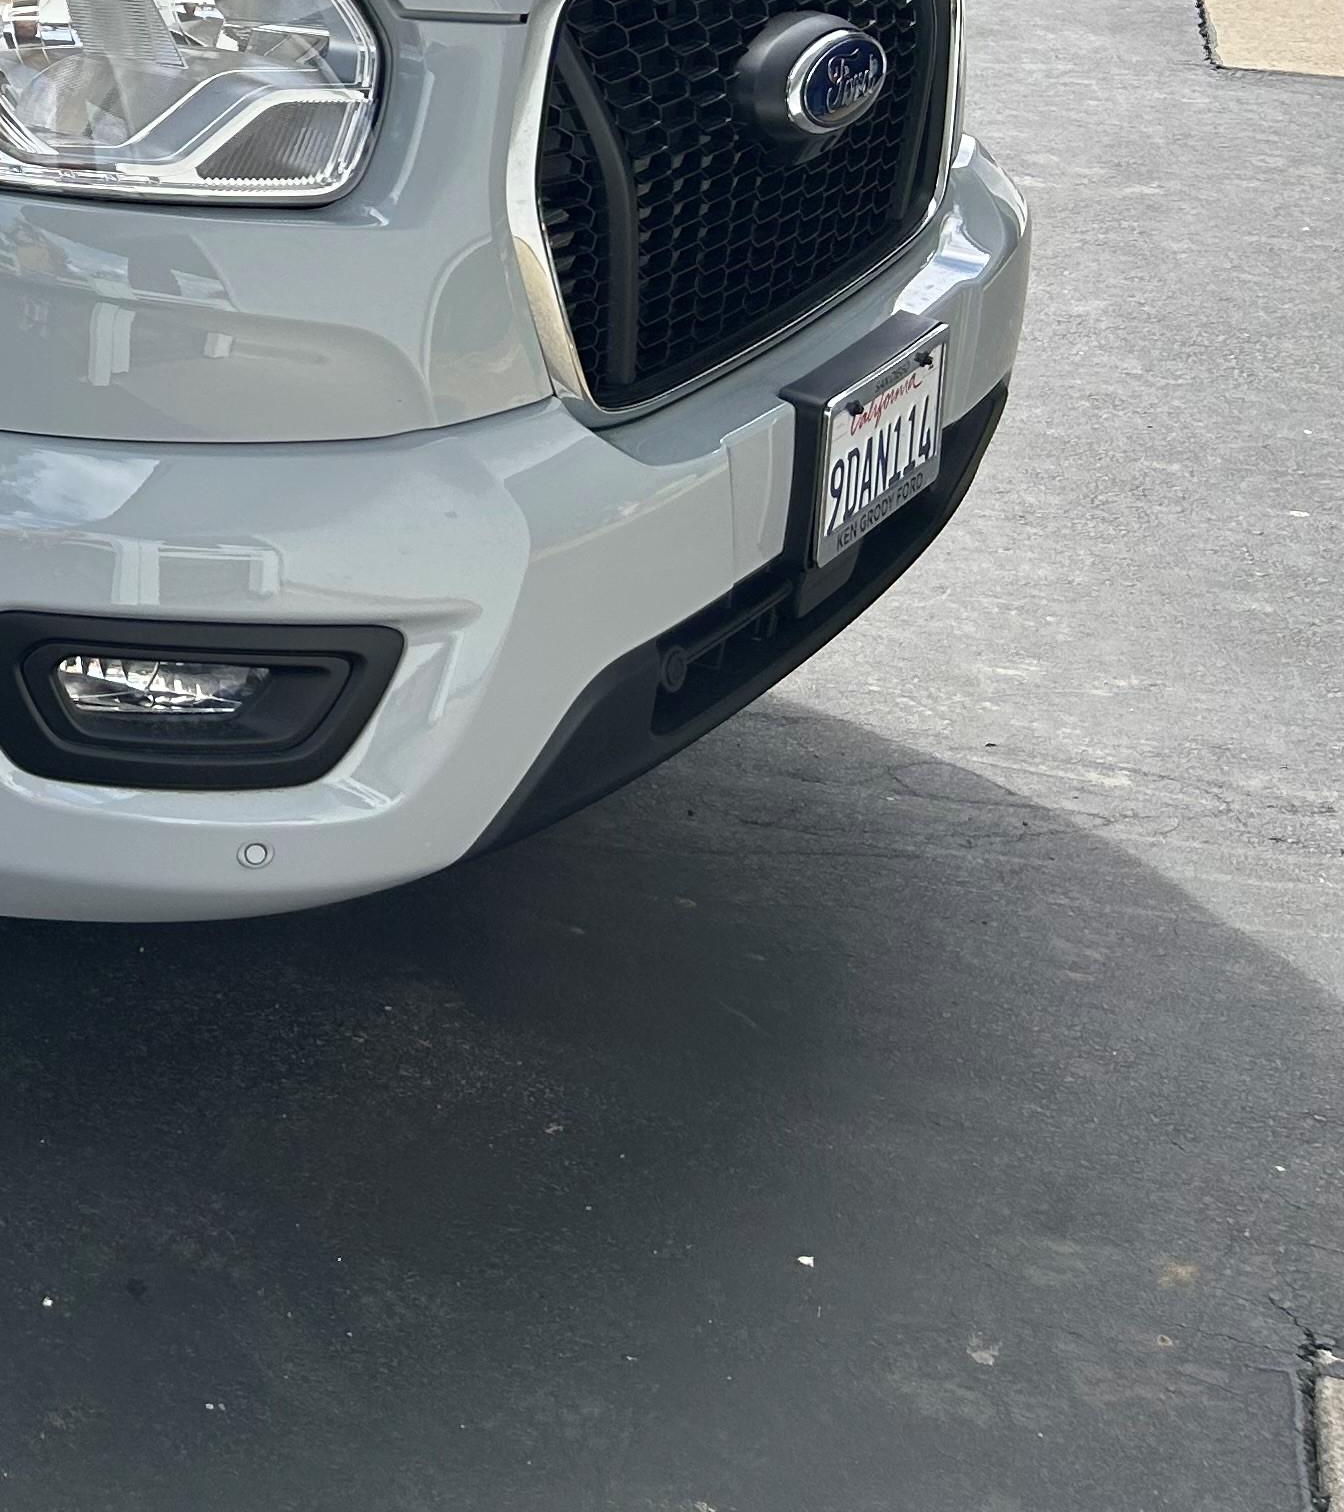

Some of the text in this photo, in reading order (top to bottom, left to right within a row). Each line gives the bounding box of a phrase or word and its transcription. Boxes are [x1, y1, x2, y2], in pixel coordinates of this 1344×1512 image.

[827, 48, 878, 113] Ford
[850, 373, 922, 435] California
[827, 395, 932, 536] 9DAN114
[837, 472, 923, 552] KEN GRODY FORD
